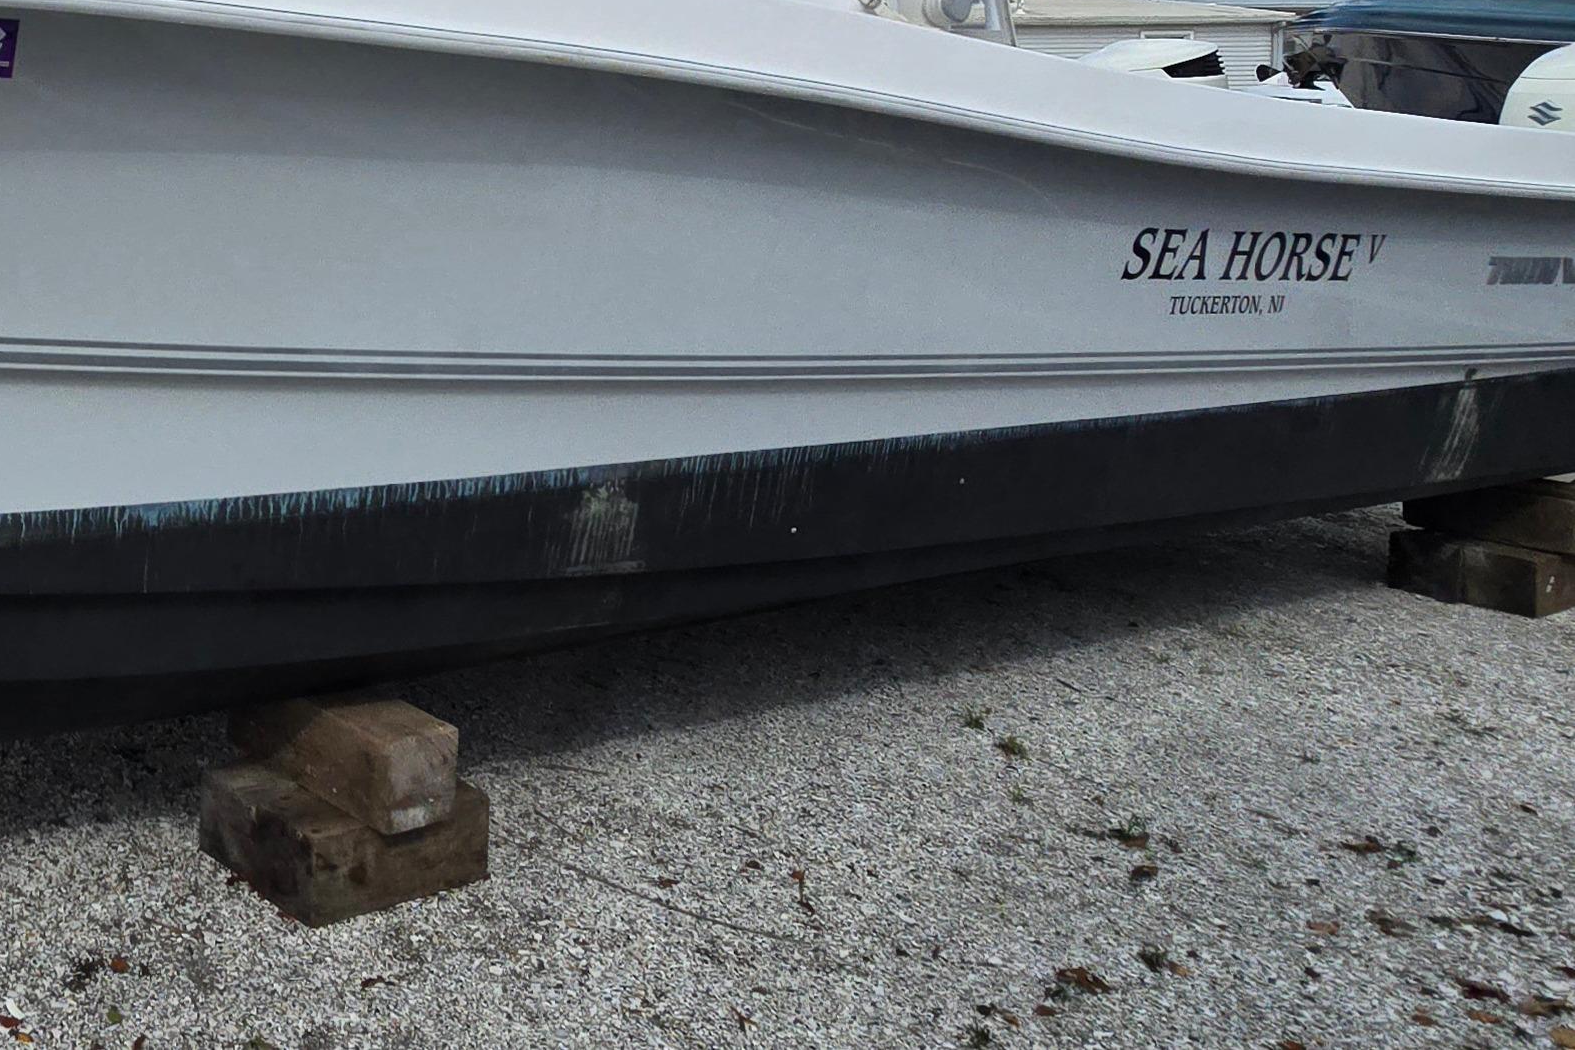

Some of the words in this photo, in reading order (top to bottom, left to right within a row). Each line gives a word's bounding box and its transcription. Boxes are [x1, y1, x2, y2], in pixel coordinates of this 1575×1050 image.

[1121, 227, 1210, 281] SEA
[1219, 231, 1361, 282] HORSE
[1368, 234, 1387, 264] V
[1169, 295, 1262, 316] TUCKERTON,
[1267, 295, 1286, 314] NJ
